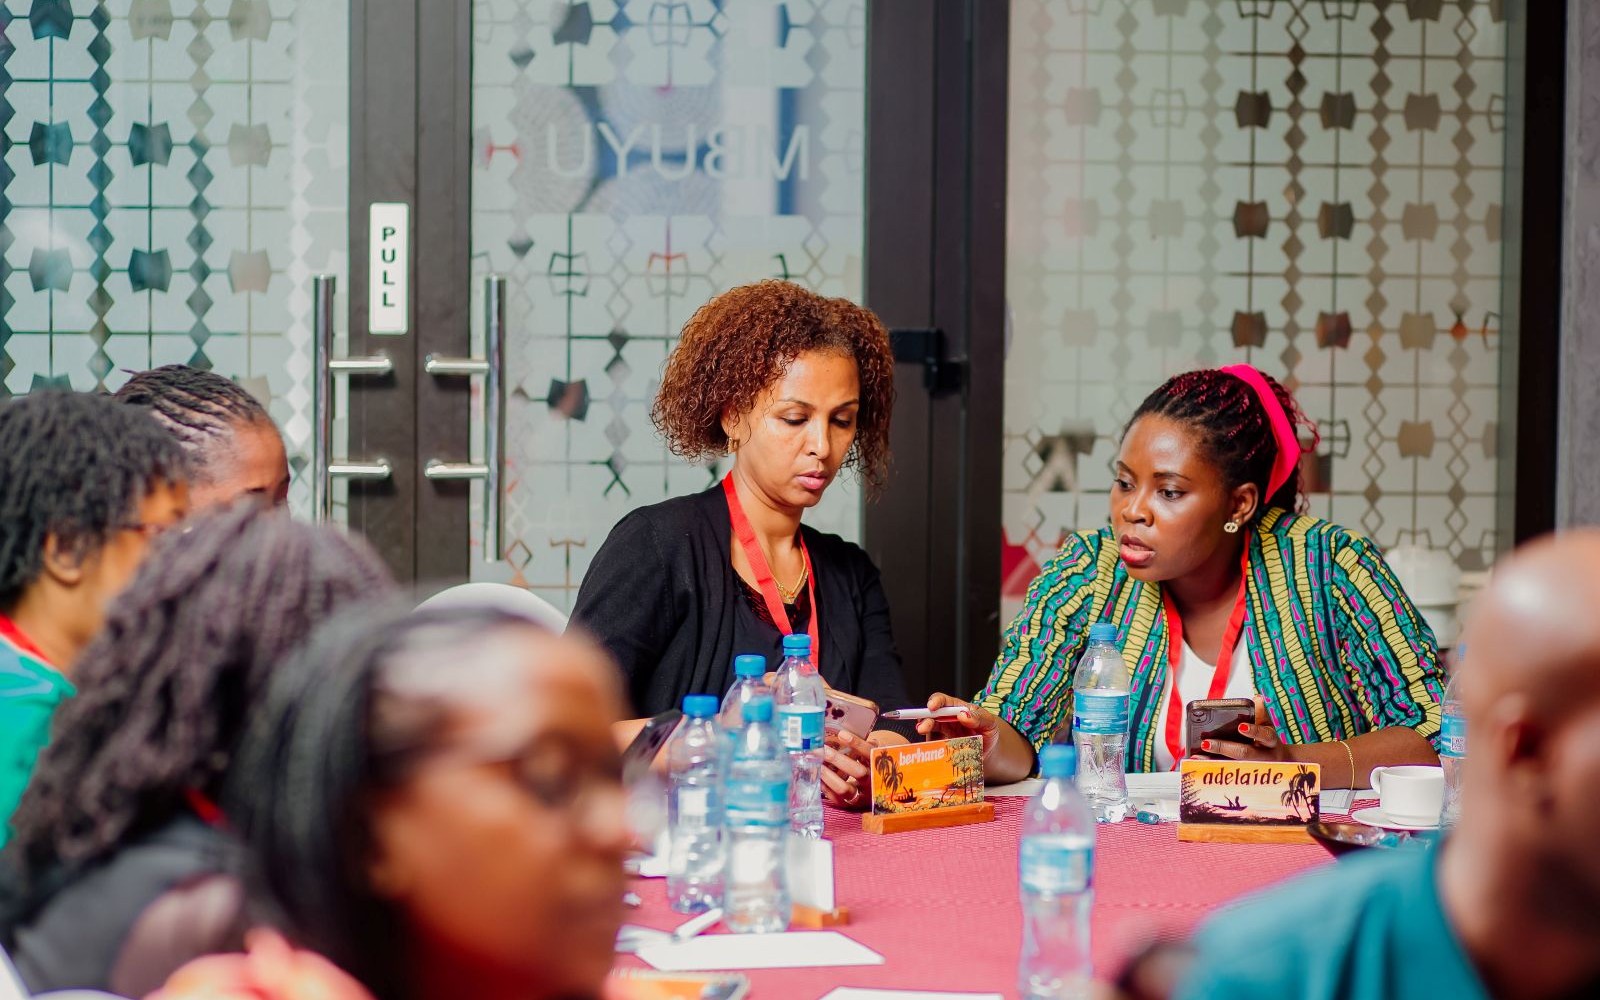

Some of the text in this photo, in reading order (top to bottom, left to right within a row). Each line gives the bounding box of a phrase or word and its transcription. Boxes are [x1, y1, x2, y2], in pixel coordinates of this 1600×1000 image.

[381, 226, 396, 307] PULL
[899, 747, 945, 767] berhane
[1202, 766, 1284, 786] adelaide
